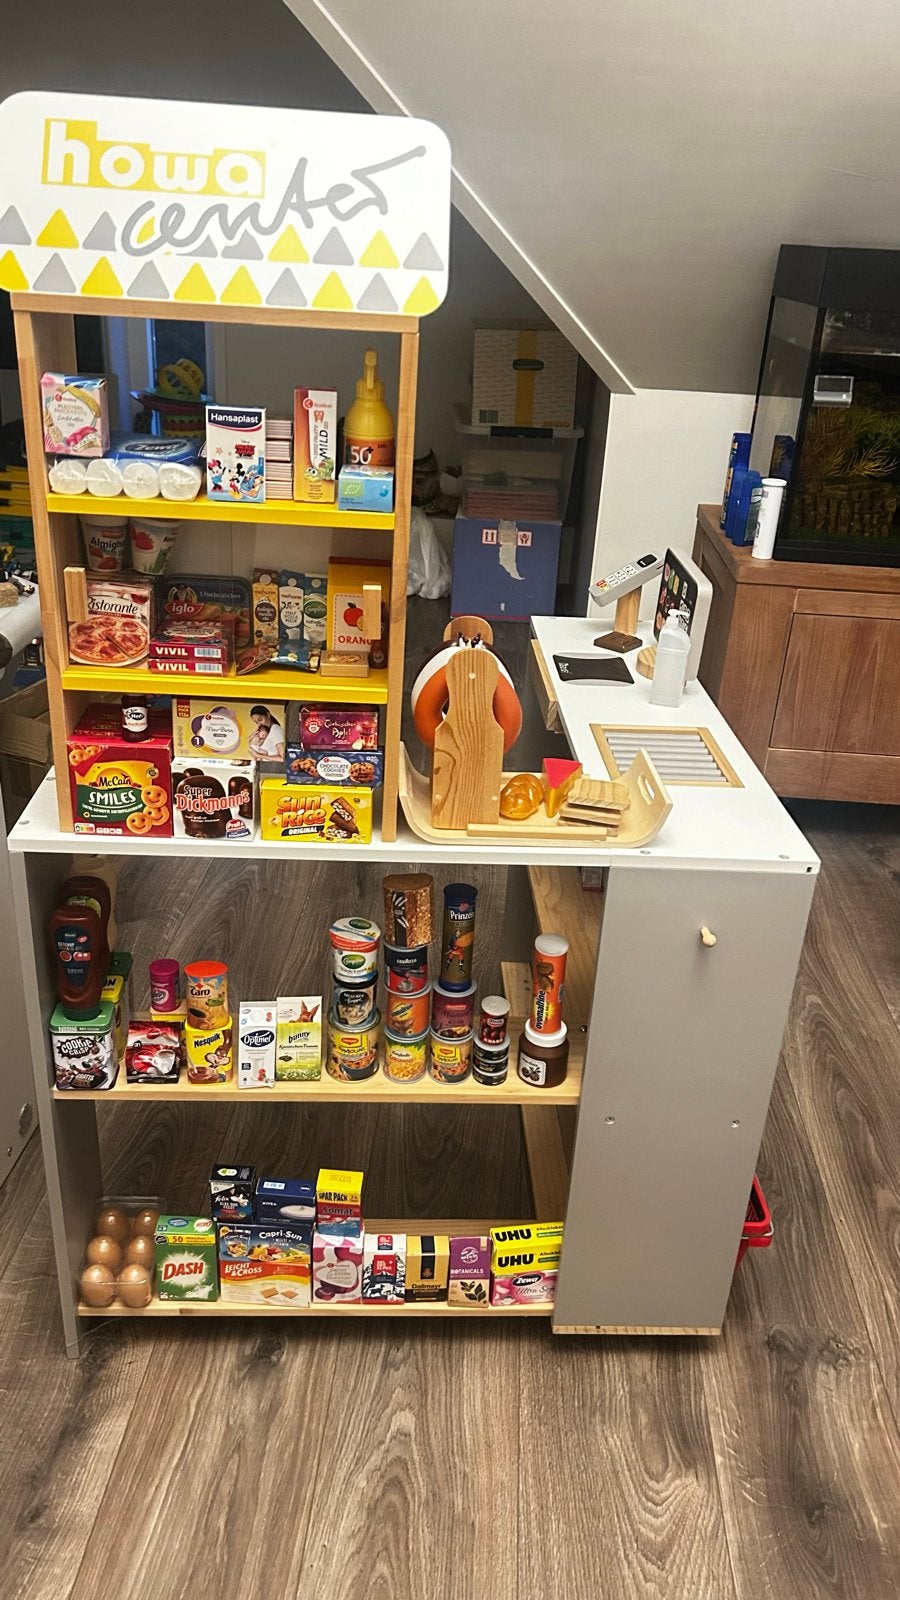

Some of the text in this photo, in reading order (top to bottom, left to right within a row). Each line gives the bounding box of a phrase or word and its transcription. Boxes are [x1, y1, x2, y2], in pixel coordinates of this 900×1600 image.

[46, 120, 264, 196] howa
[121, 145, 427, 257] center
[210, 412, 259, 424] Hansaplast
[318, 429, 329, 460] MILD
[172, 603, 195, 615] iglo
[155, 647, 188, 656] VIVIL
[156, 662, 189, 672] VIVIL
[194, 736, 200, 746] 1
[98, 775, 132, 788] McCain
[184, 785, 213, 798] Super
[88, 790, 136, 806] SMILES
[175, 791, 251, 815] Dickmann's
[288, 827, 318, 835] ORIGINAL
[190, 988, 210, 996] Caro
[193, 1033, 221, 1048] Nesquik
[244, 1031, 272, 1045] Optimel
[288, 1031, 311, 1043] bunny
[319, 1192, 333, 1200] SPAR
[334, 1193, 348, 1202] PACK
[323, 1206, 353, 1215] Somat
[172, 1235, 183, 1243] 50
[259, 1230, 303, 1241] Capri-Sun
[495, 1228, 532, 1242] UHU
[497, 1253, 534, 1268] UHU
[163, 1261, 205, 1281] DASH
[225, 1263, 250, 1274] LEICHT
[231, 1266, 263, 1277] &CROSS
[516, 1277, 540, 1285] Zewa
